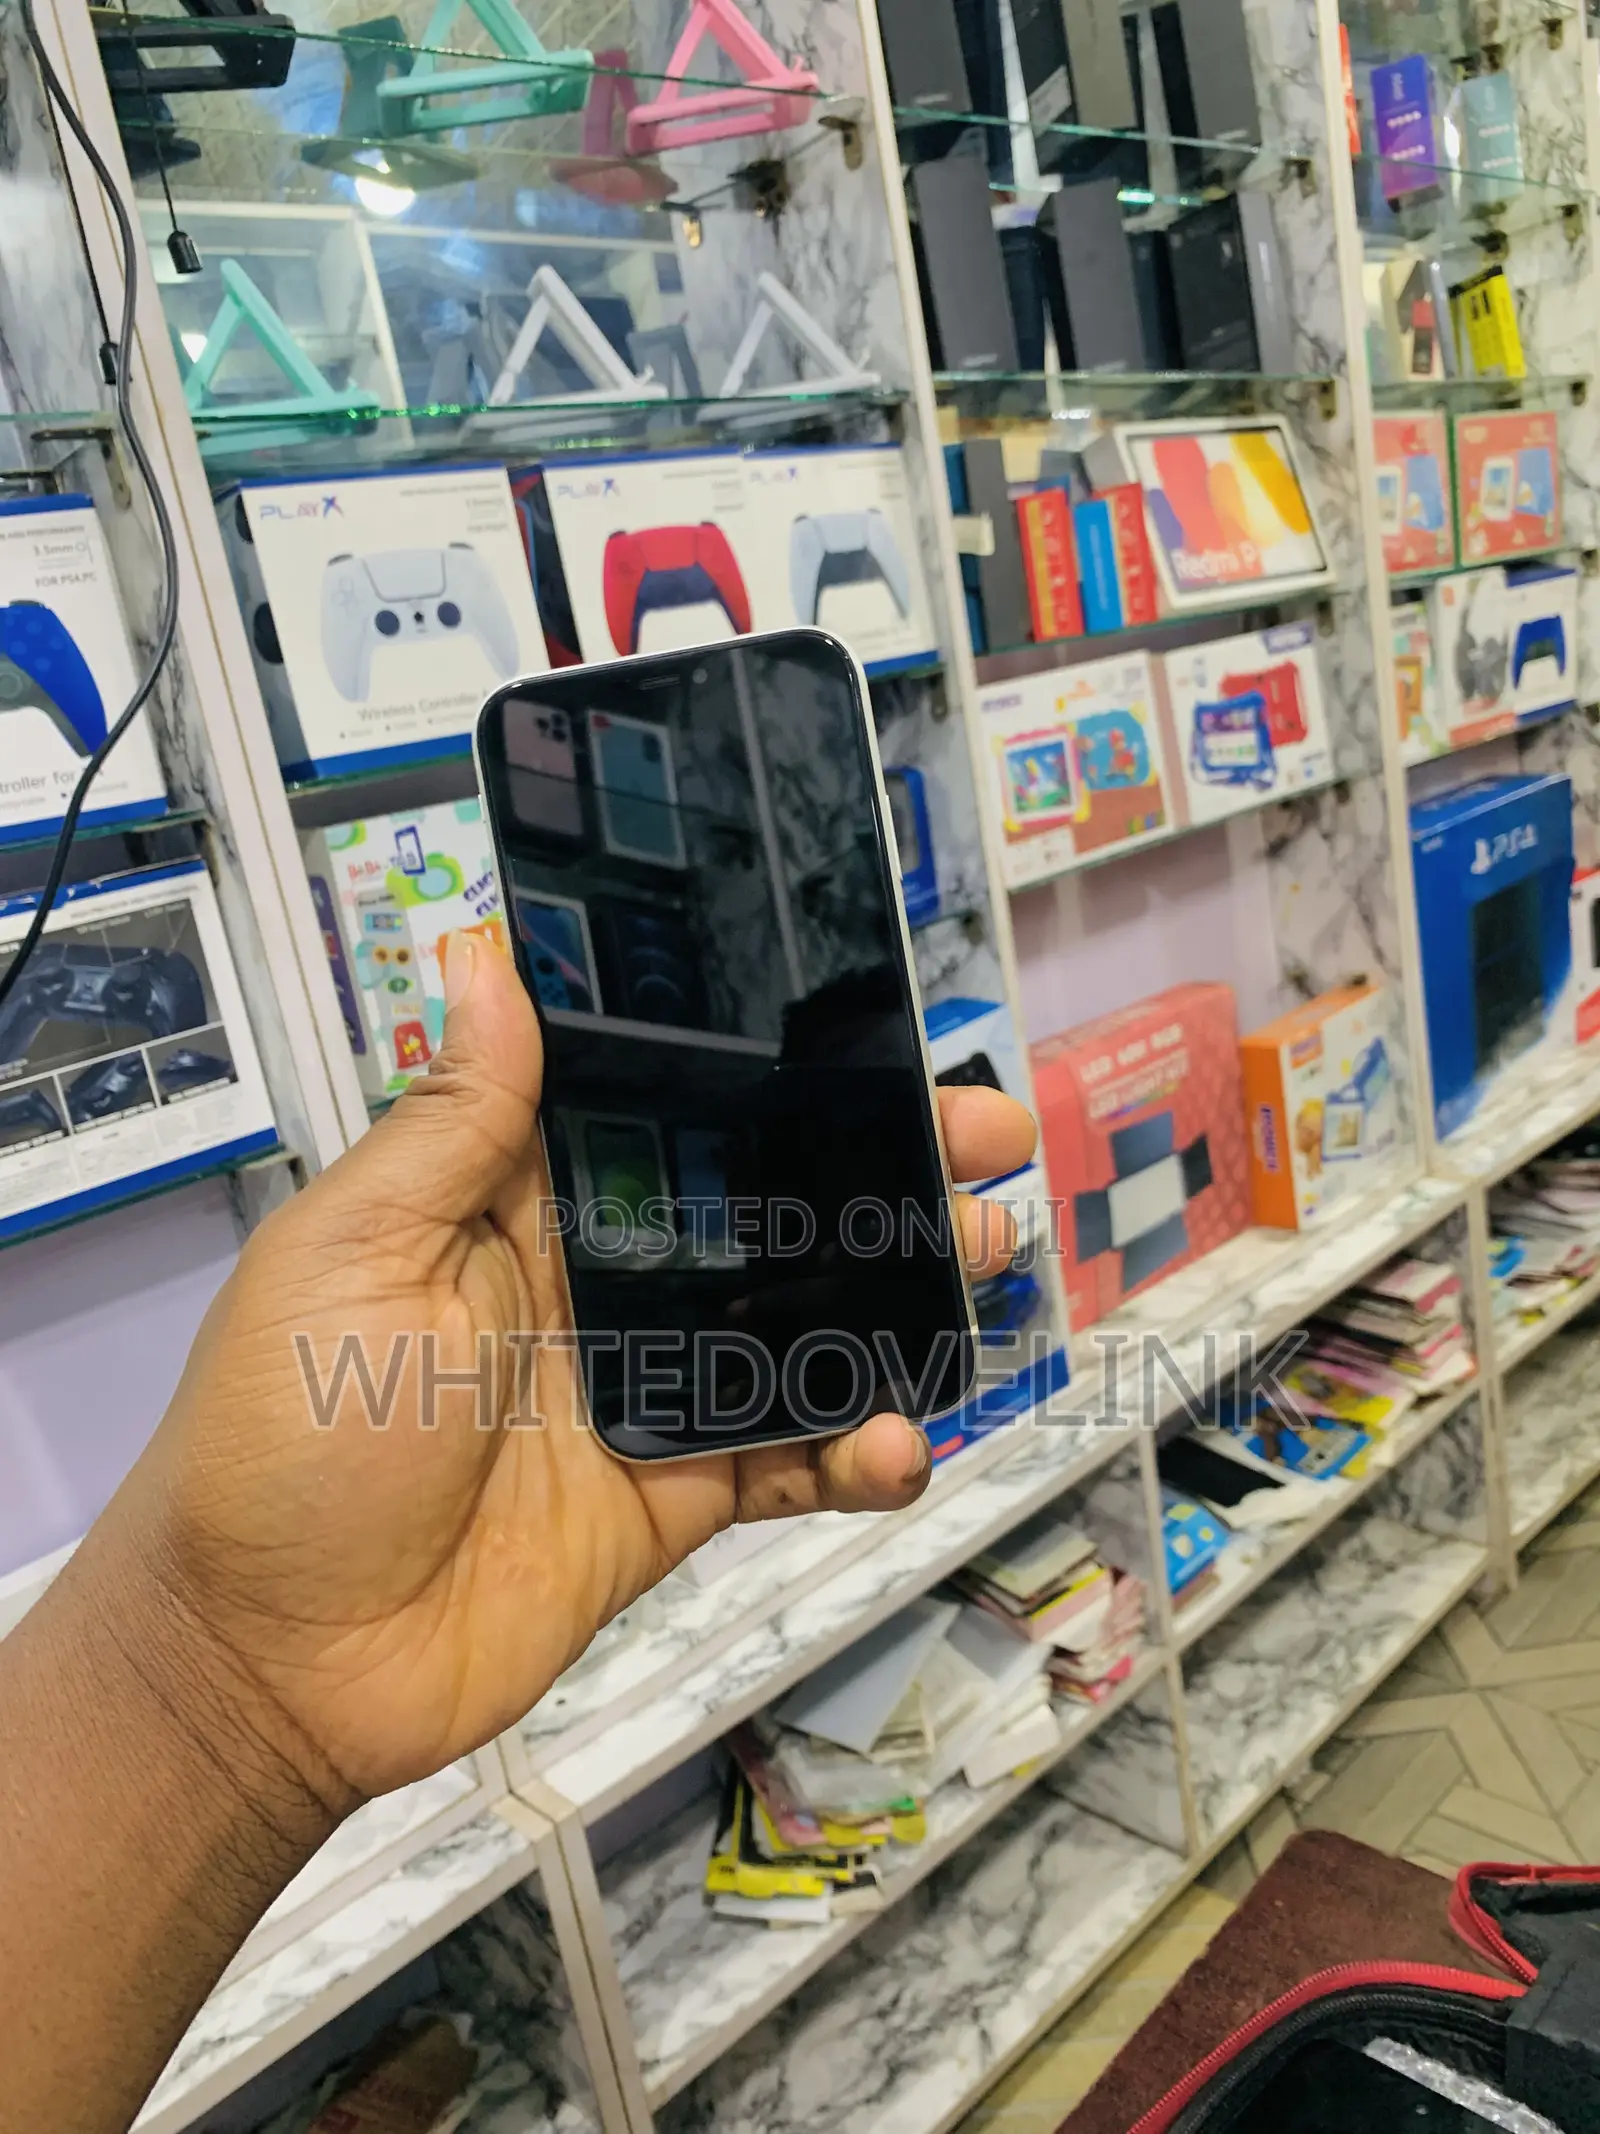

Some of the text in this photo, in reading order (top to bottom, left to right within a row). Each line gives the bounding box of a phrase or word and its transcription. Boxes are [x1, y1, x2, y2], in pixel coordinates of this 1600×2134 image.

[259, 496, 345, 520] PLAYX
[357, 704, 416, 721] Wireless
[0, 771, 76, 795] troller for
